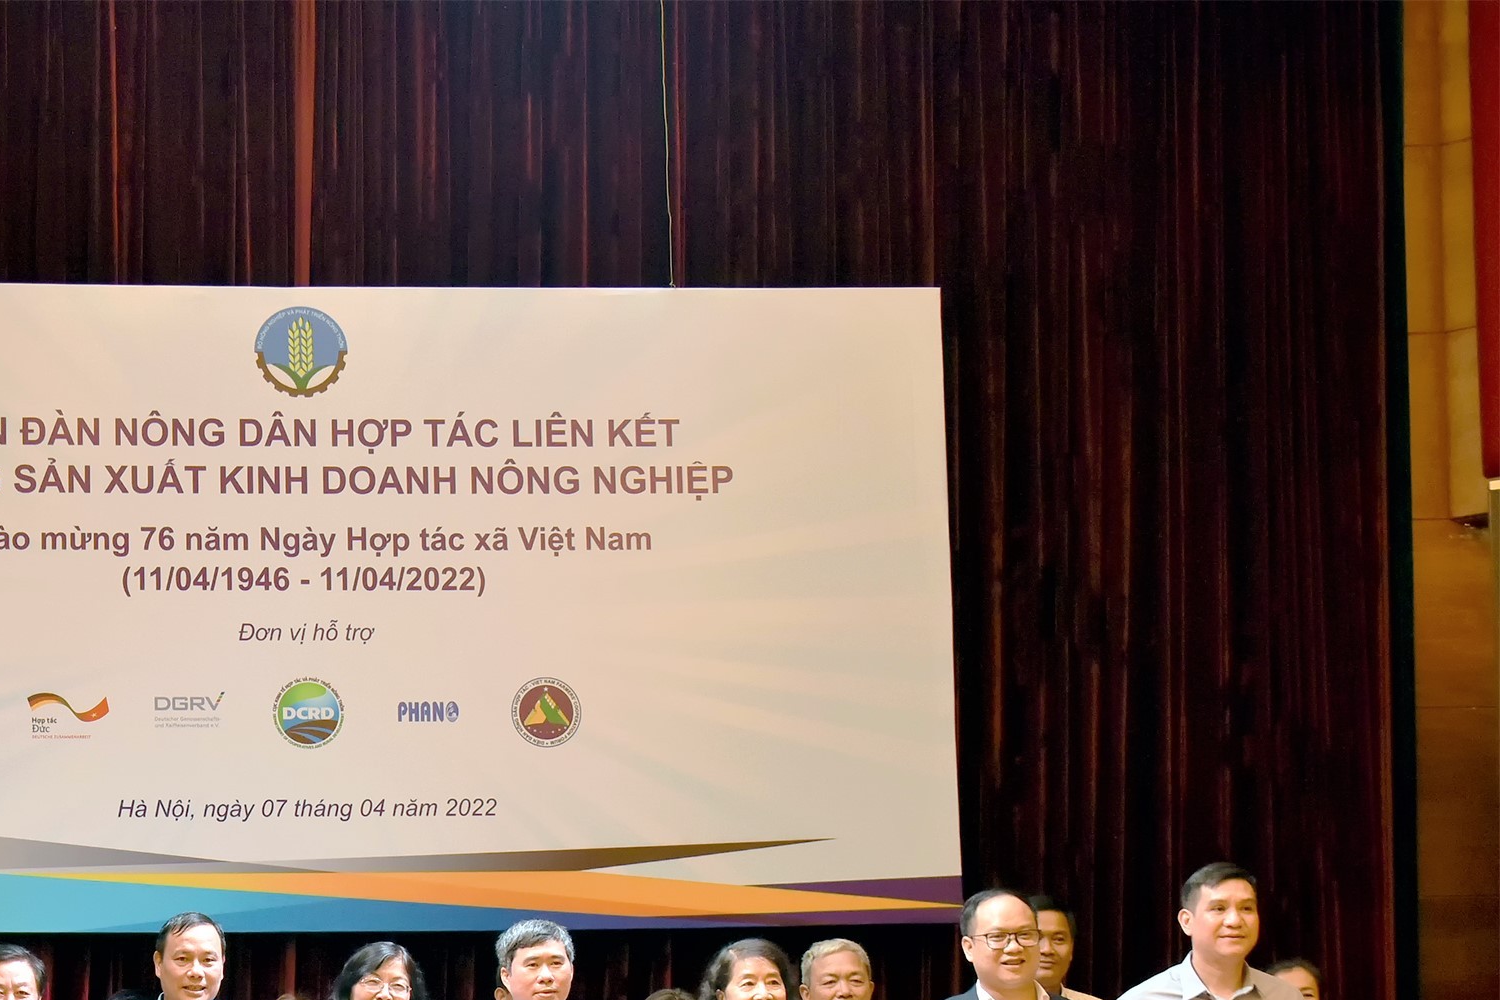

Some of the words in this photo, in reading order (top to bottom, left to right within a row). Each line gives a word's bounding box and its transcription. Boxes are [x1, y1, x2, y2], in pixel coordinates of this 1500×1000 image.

[19, 409, 100, 446] ĐÀN
[115, 410, 225, 447] NÔNG
[239, 411, 316, 447] DÂN
[332, 419, 412, 454] HỢP
[423, 411, 498, 447] TÁC
[513, 411, 594, 447] LIÊN
[608, 412, 680, 447] KẾT
[14, 458, 91, 494] SẢN
[104, 458, 206, 494] XUẤT
[220, 466, 307, 494] KINH
[323, 466, 457, 494] DOANH
[470, 459, 580, 494] NÔNG
[594, 461, 734, 501] NGHIỆP
[41, 526, 129, 557] mừng
[141, 527, 174, 551] 76
[186, 526, 249, 551] năm
[260, 526, 336, 557] Ngày
[347, 527, 410, 557] Hợp
[419, 526, 464, 551] tác
[474, 526, 508, 551] xã
[518, 526, 575, 557] Việt
[586, 527, 652, 551] Nam
[122, 566, 290, 597] (11/04/1946
[320, 566, 486, 597] 11/04/2022)
[239, 622, 282, 641] Đơn
[289, 622, 307, 645] vị
[313, 620, 339, 641] hỗ
[345, 622, 376, 645] trợ
[154, 692, 225, 711] DGRV
[282, 706, 335, 720] DCRD
[32, 724, 50, 733] Đức
[118, 799, 147, 818] Hà
[155, 799, 194, 822] Nội,
[203, 799, 255, 822] ngày
[261, 799, 287, 818] 07
[294, 799, 353, 822] tháng
[360, 799, 385, 818] 04
[392, 798, 438, 818] năm
[445, 798, 498, 817] 2022
